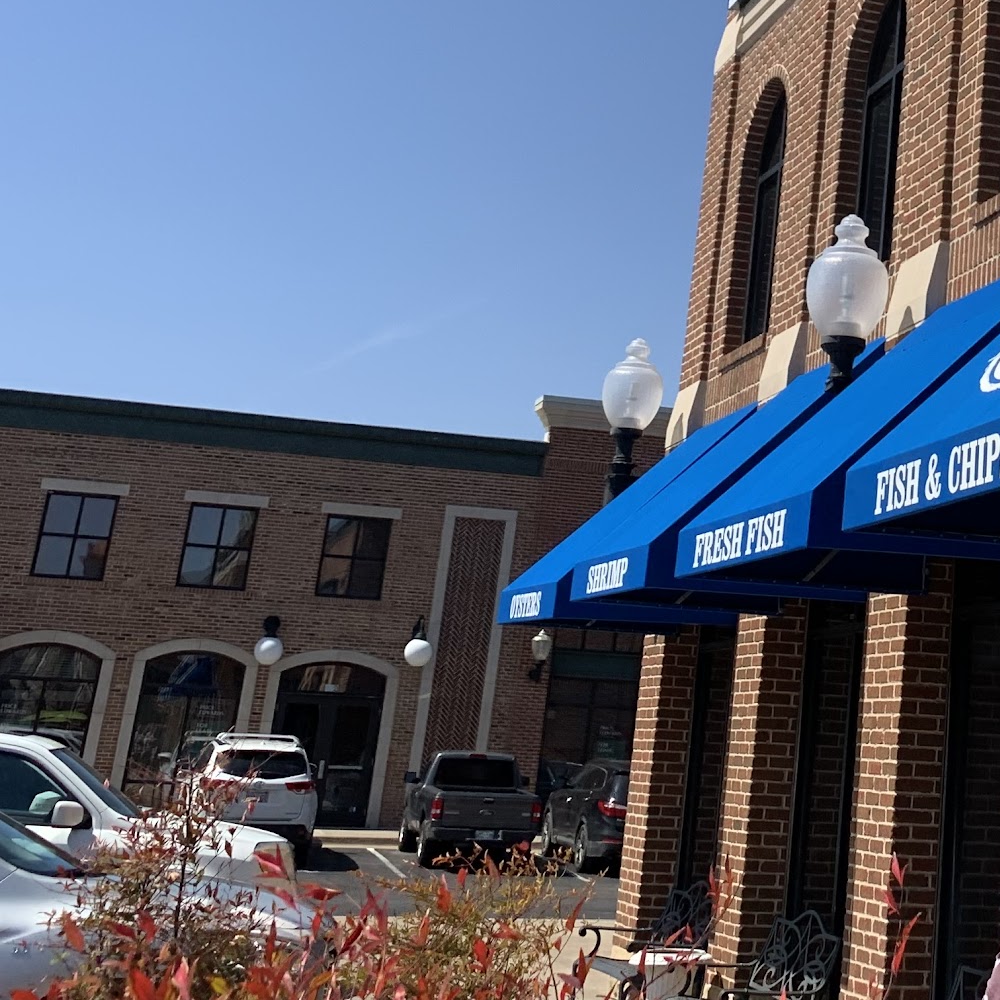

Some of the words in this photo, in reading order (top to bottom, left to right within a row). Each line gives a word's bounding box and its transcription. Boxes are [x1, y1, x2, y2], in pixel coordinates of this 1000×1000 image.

[874, 459, 921, 515] FISH
[925, 453, 941, 500] &
[692, 521, 745, 569] FRESH
[745, 508, 787, 555] FISH
[586, 556, 629, 594] SHRIMP
[510, 591, 542, 619] OYSTERS
